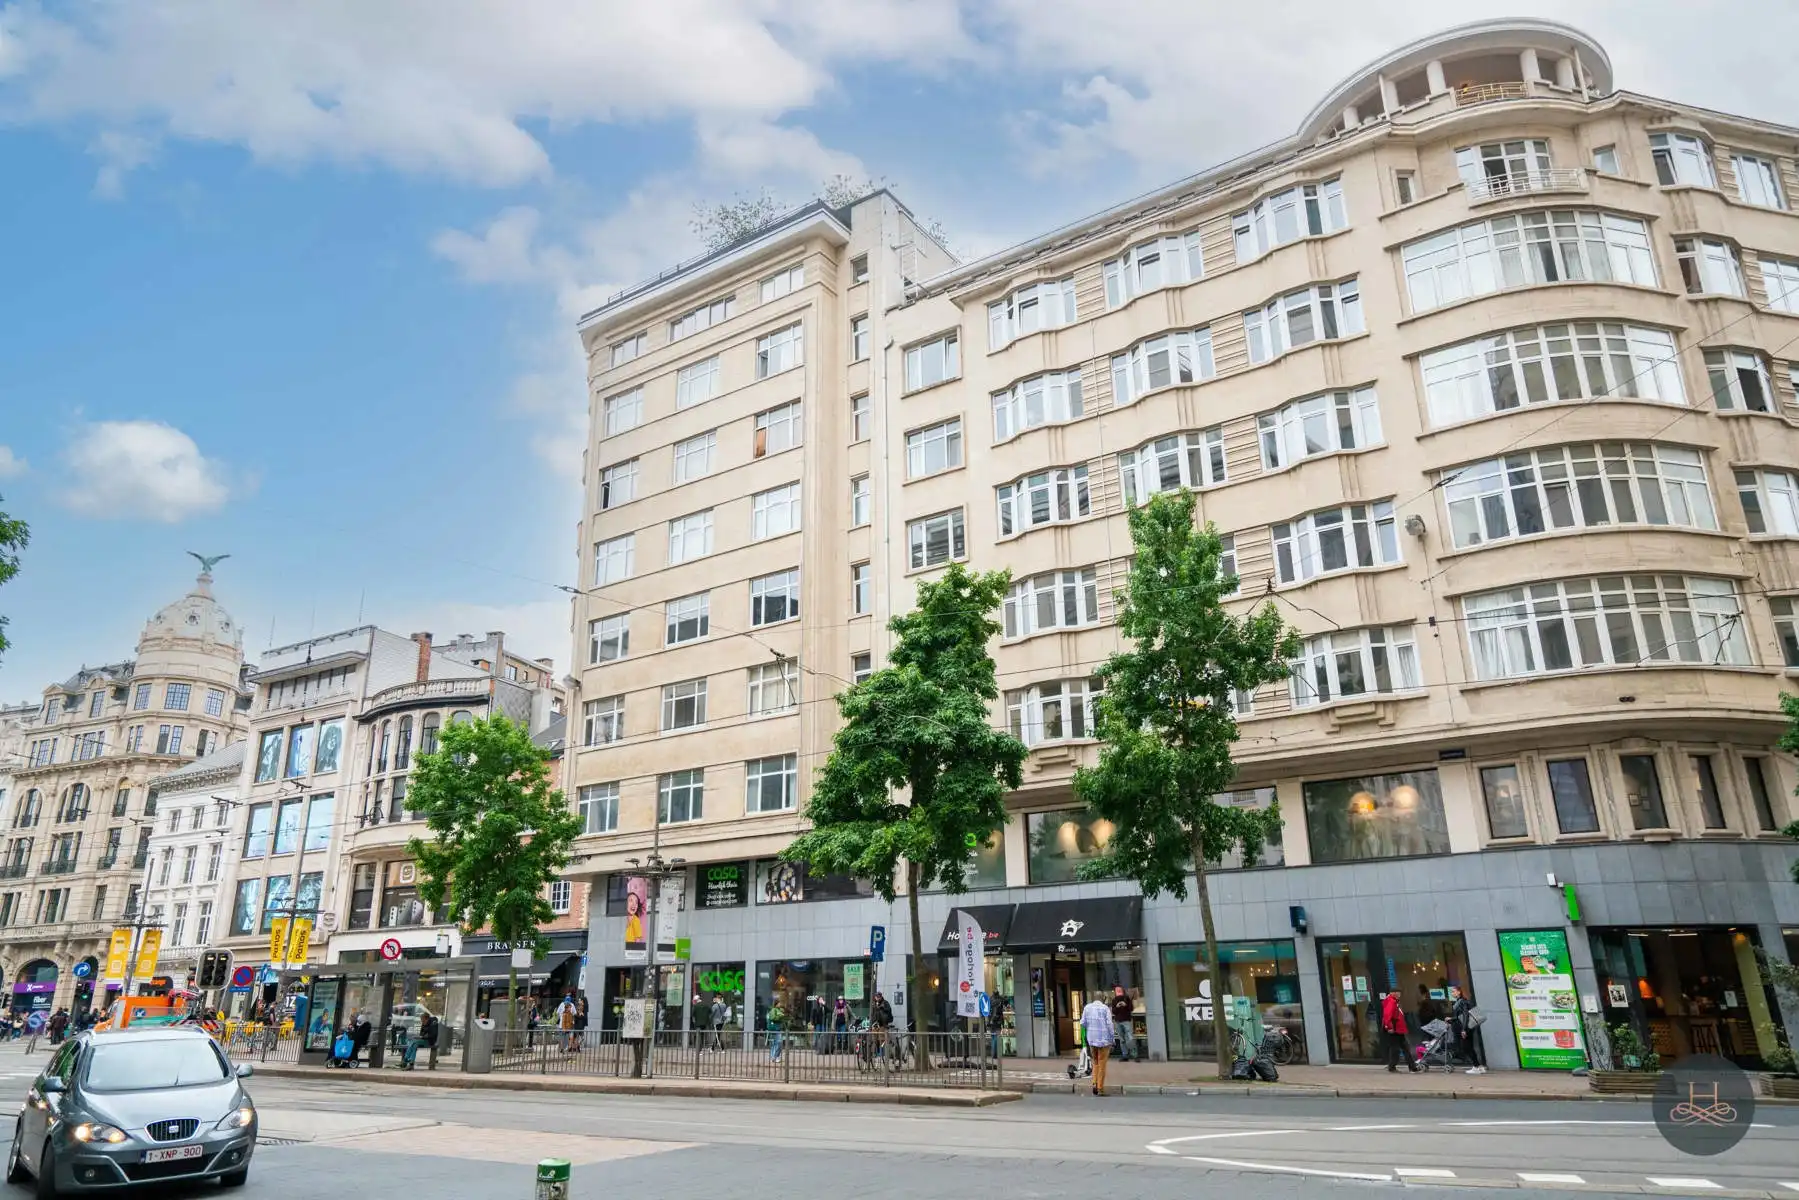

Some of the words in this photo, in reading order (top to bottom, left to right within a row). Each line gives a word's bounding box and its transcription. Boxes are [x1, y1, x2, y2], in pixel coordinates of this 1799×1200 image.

[273, 929, 281, 959] Panos
[296, 930, 306, 960] Panos
[873, 930, 883, 949] P
